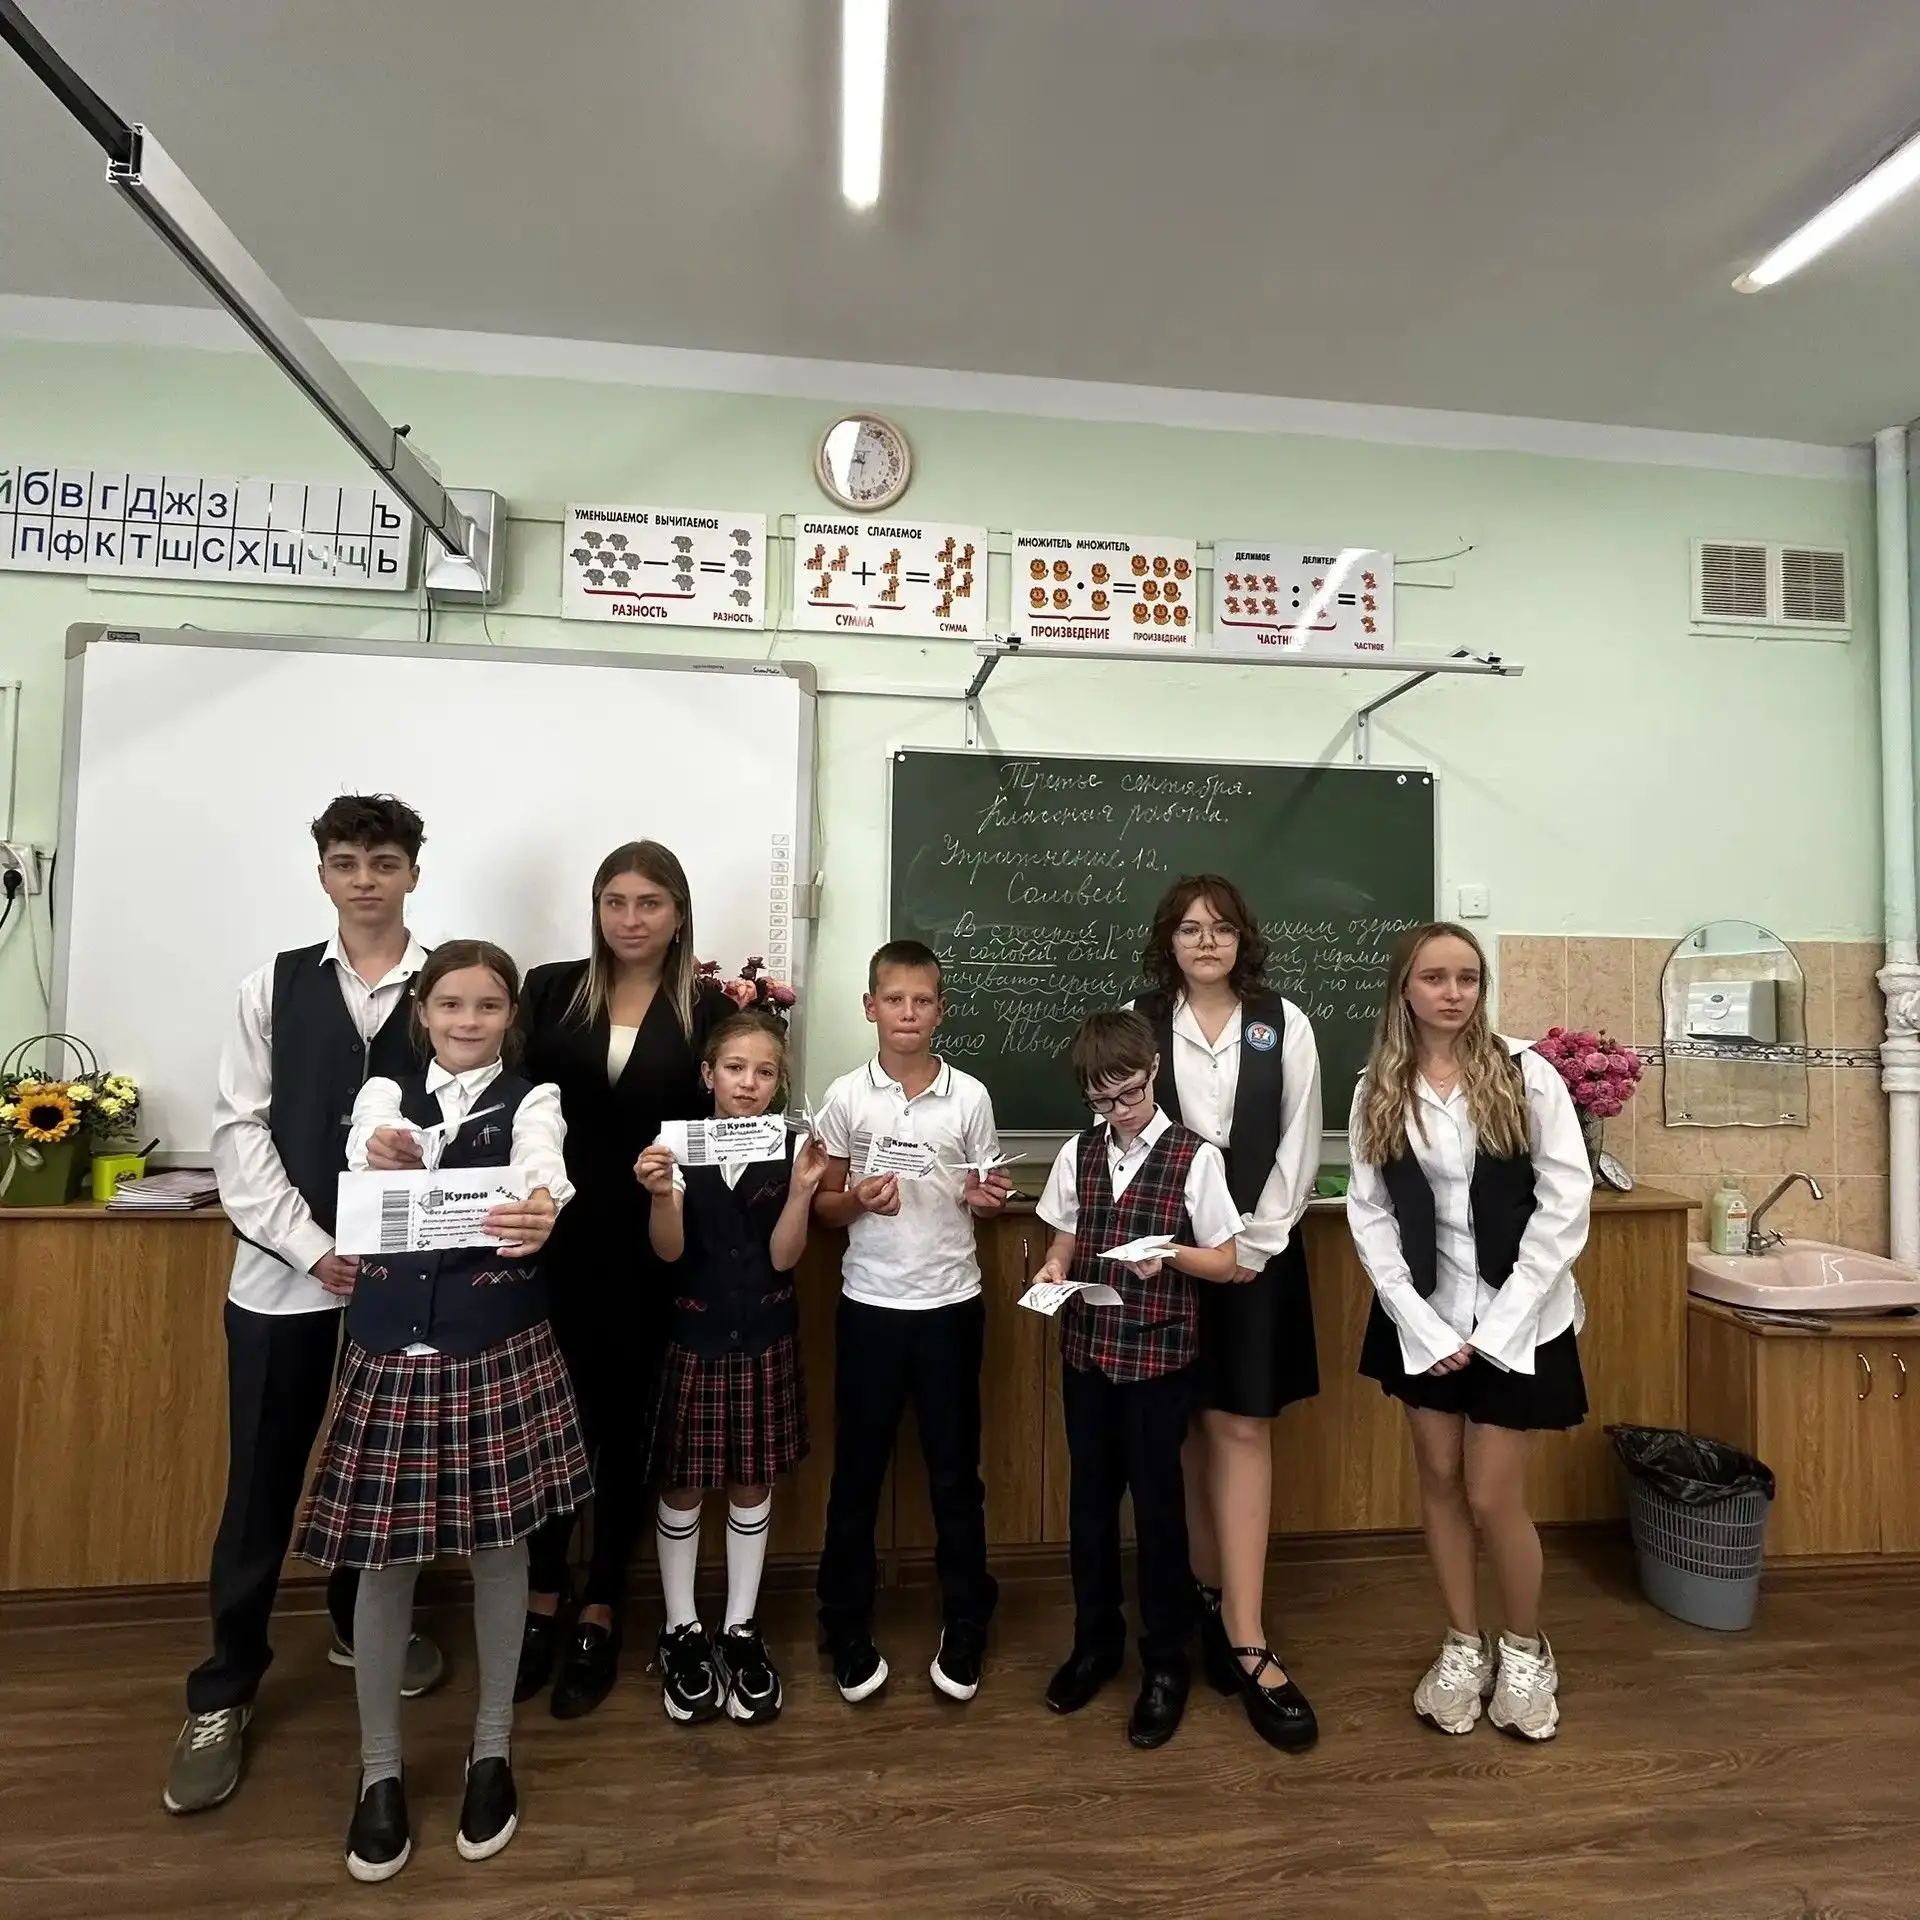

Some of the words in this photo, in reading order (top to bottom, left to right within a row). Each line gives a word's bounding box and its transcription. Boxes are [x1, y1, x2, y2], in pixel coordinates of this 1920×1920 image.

[24, 471, 50, 506] б
[574, 509, 649, 525] УМЕНЬШАЕМОЕ
[655, 513, 719, 530] ВЫЧИТАЕМОЕ
[803, 522, 859, 537] СЛАГАЕМОЕ
[867, 526, 922, 540] СЛАГАЕМОЕ
[1017, 536, 1073, 550] МНОЖИТЕЛЬ
[1076, 538, 1131, 553] МНОЖИТЕЛЬ
[1235, 551, 1271, 563] ДЕЛИМОЕ
[611, 603, 668, 620] РАЗНОСТЬ
[712, 611, 754, 624] РАЗНОСТЬ
[835, 614, 875, 629] СУММА
[938, 622, 969, 634] СУММА
[1030, 625, 1110, 641] ПРОИЗВЕДЕНИЕ
[1132, 631, 1187, 644] ПРОИЗВЕДЕНИЕ
[1354, 641, 1386, 652] ЧАСТНОЕ
[1007, 872, 1128, 906] Соловей
[953, 909, 976, 938] В
[444, 1191, 488, 1202] Купон
